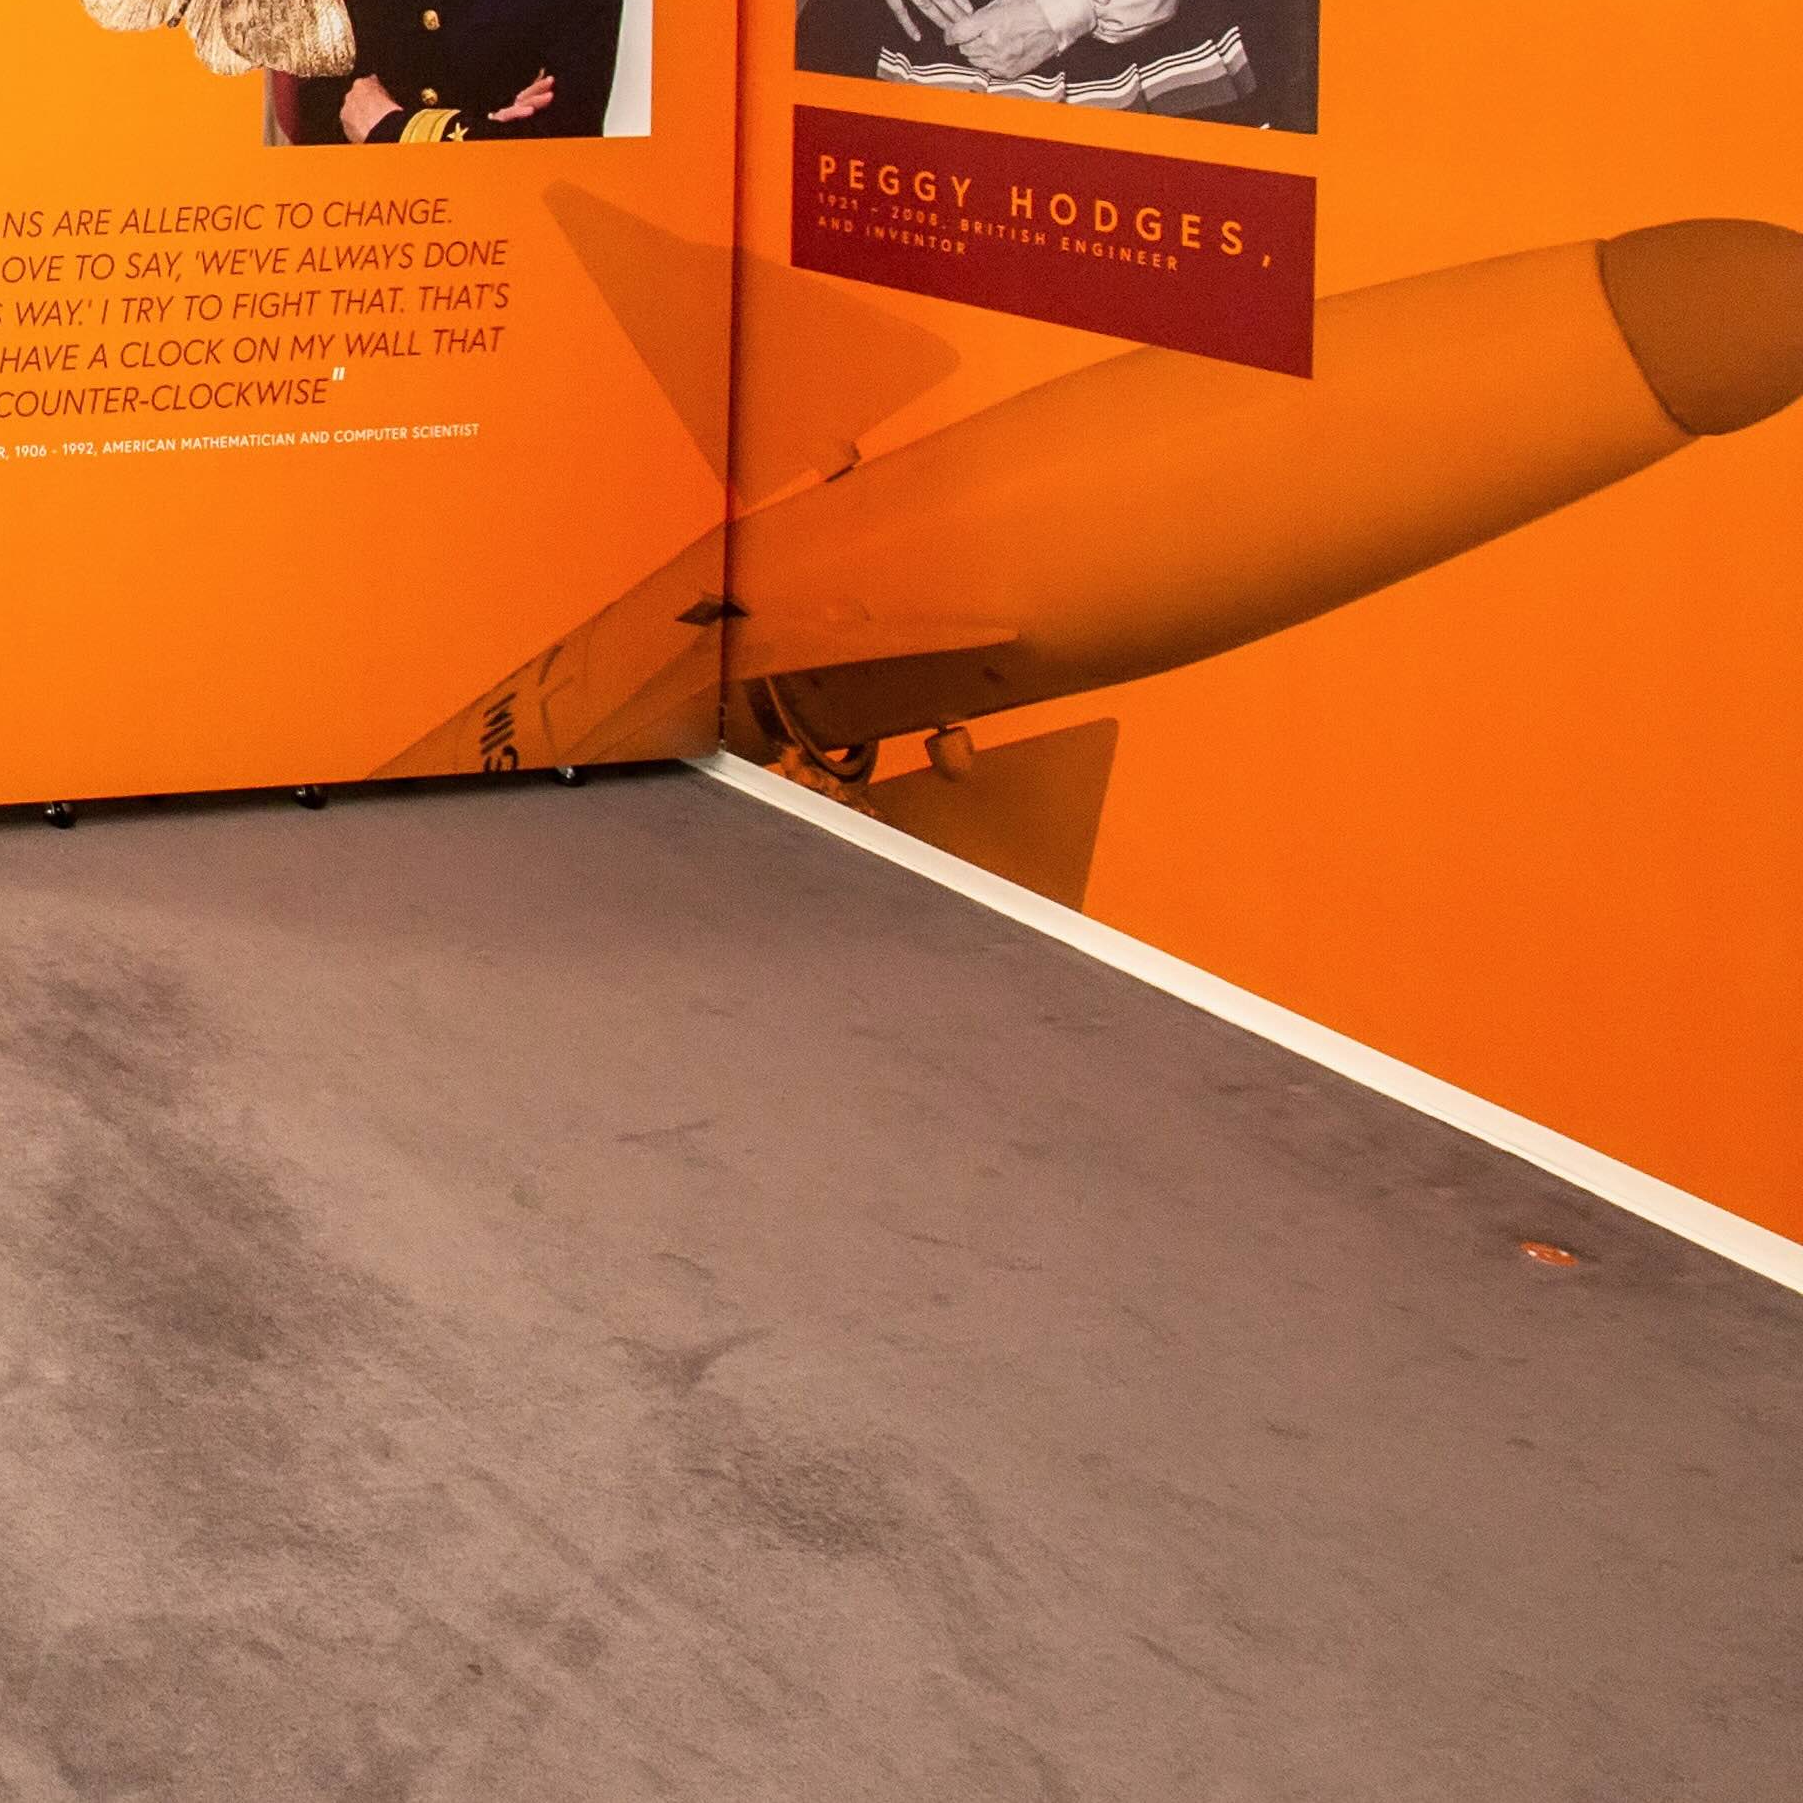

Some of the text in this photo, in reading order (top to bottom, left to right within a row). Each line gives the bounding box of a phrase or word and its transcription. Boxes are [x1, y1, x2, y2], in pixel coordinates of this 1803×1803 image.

[52, 209, 112, 237] ARE
[119, 203, 265, 235] ALLERGIC
[275, 202, 314, 230] TO
[322, 197, 453, 228] CHANGE.
[820, 154, 1271, 268] PEGGY HODGES,
[818, 216, 966, 255] AND INVENTOR
[960, 218, 1046, 246] BRITISH
[1061, 236, 1178, 271] ENGINEER
[15, 444, 48, 457] 1906
[62, 441, 97, 456] 1992,
[102, 438, 177, 455] AMERICAN
[181, 433, 296, 449] MATHEMATICIAN
[300, 430, 331, 444] AND
[333, 427, 408, 443] COMPUTER
[413, 423, 479, 438] SCIENTIST
